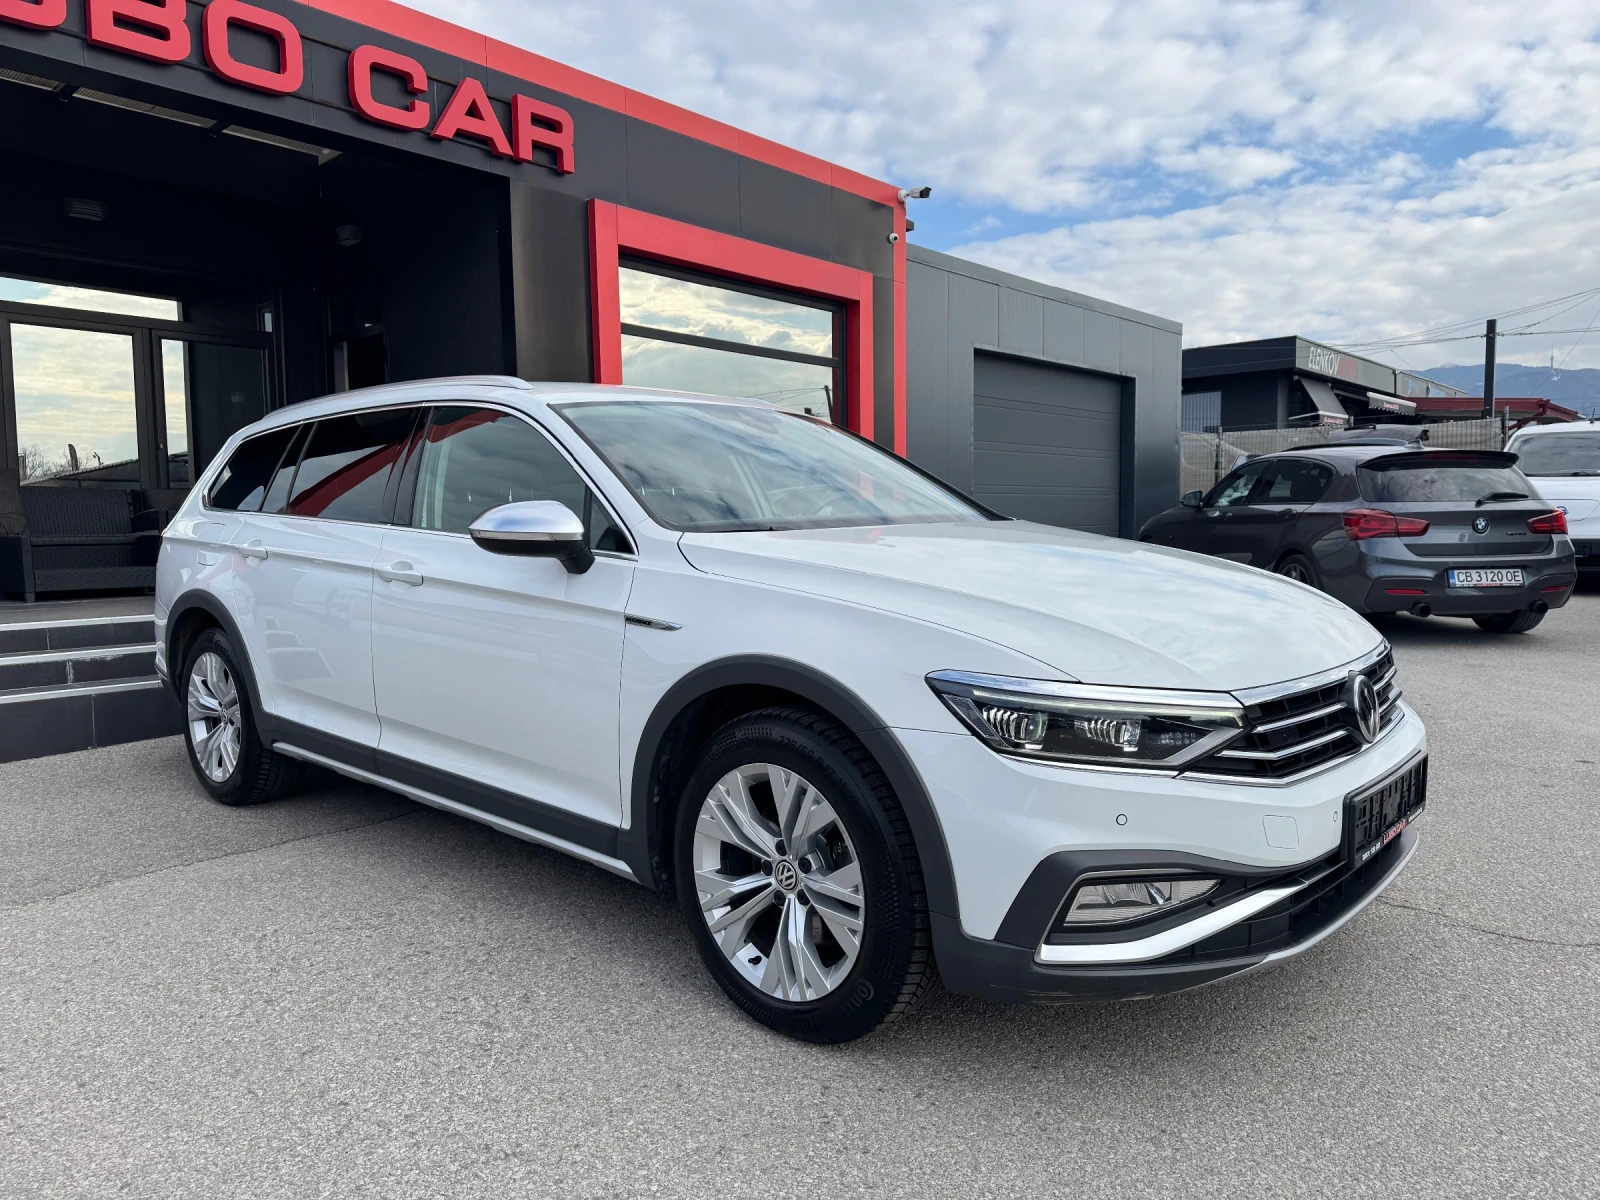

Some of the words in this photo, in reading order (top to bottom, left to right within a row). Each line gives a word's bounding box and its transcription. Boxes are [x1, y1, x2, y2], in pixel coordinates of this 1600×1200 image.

[347, 44, 575, 175] CAR
[1308, 346, 1341, 376] ELENKOV
[1457, 571, 1474, 583] CB
[1475, 570, 1504, 583] 3120
